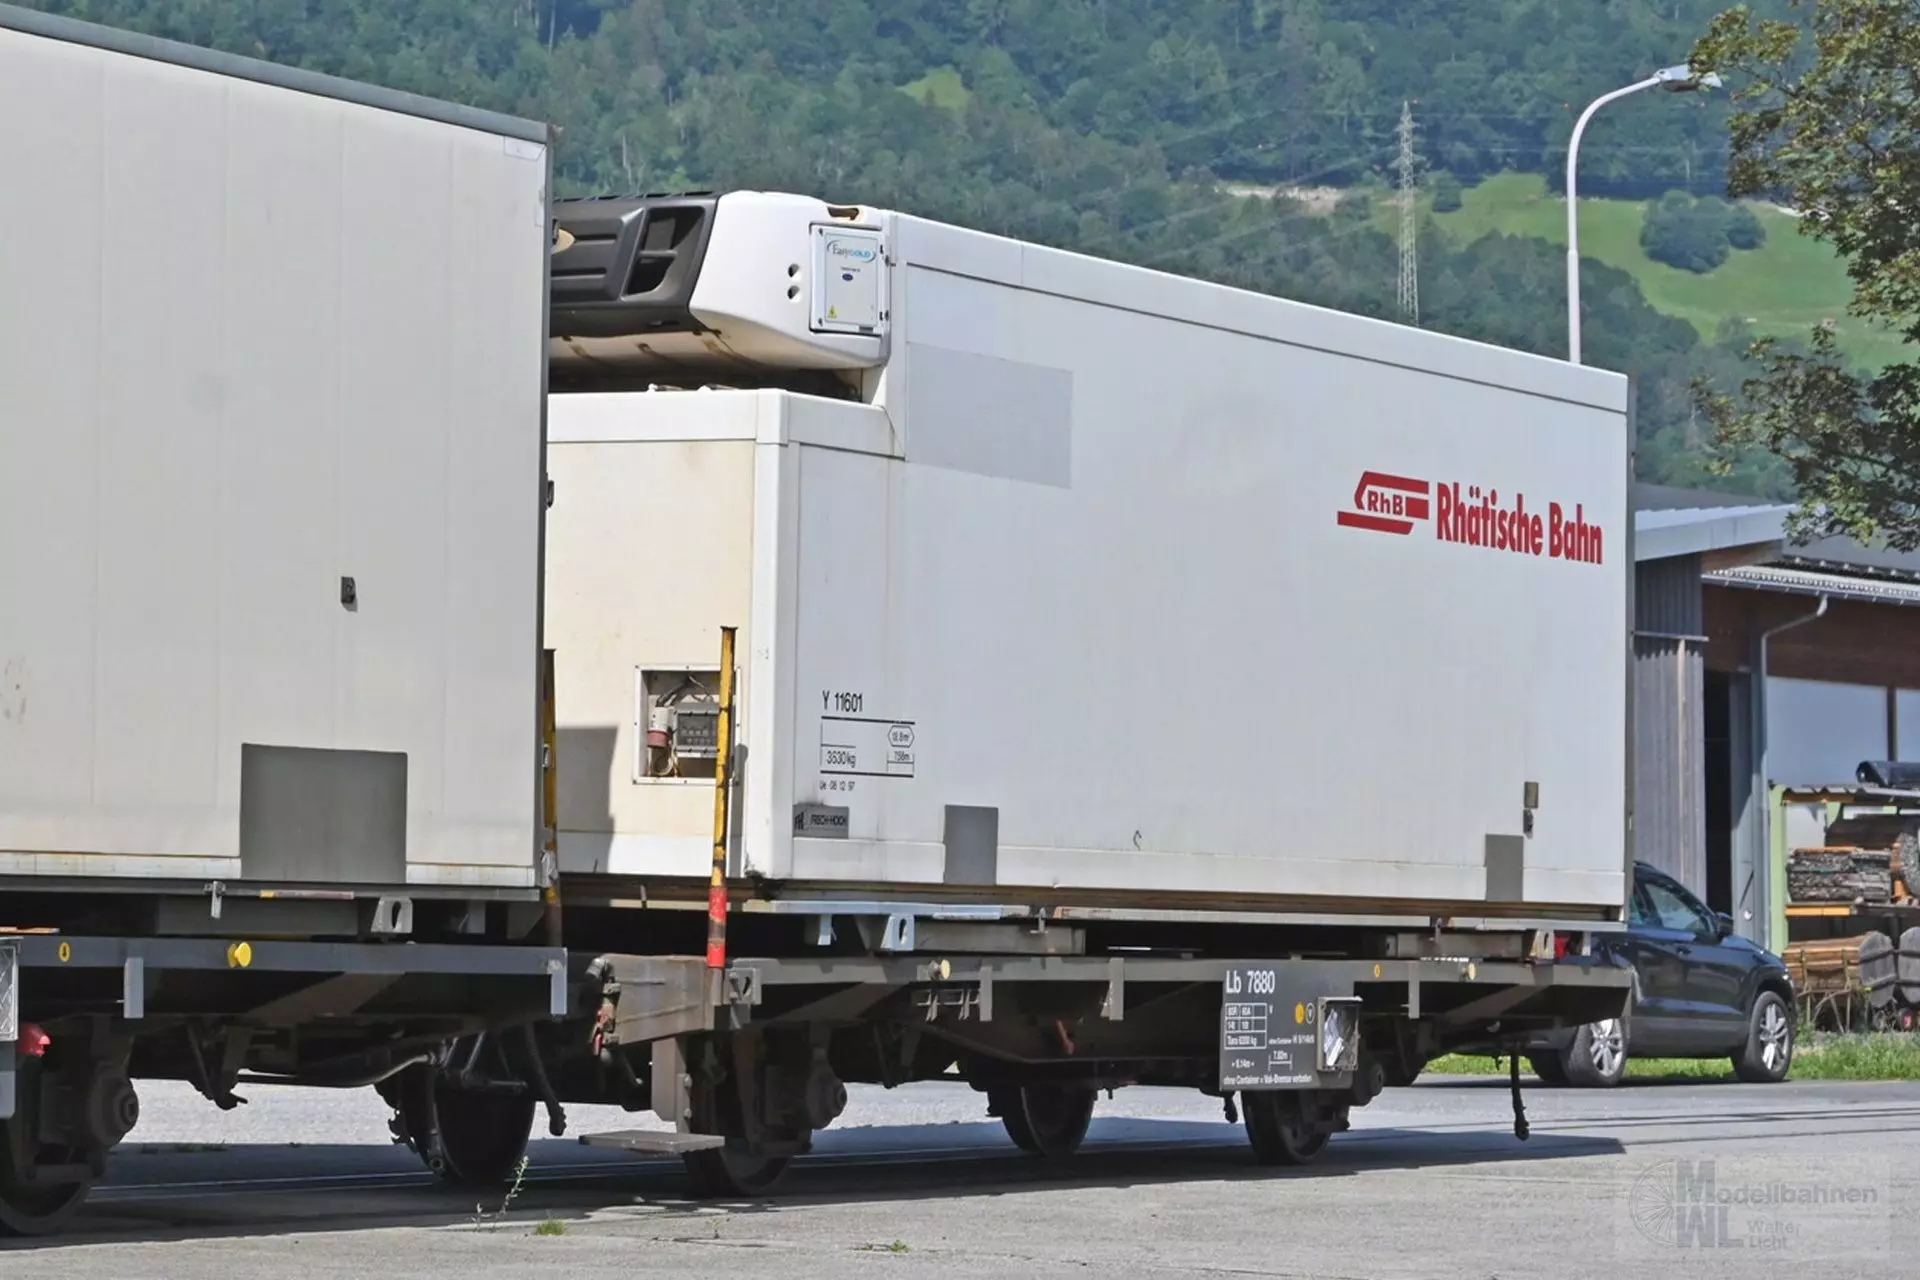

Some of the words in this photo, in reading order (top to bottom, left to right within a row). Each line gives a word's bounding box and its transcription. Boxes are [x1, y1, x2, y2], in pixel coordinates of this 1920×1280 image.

[1367, 490, 1404, 516] RhB
[1436, 481, 1544, 556] Rhätische
[1548, 502, 1603, 565] Bahn
[822, 690, 830, 710] Y
[834, 692, 864, 713] 11601
[1225, 970, 1242, 994] Lb
[1246, 970, 1276, 995] 7880
[1236, 1075, 1260, 1085] Container
